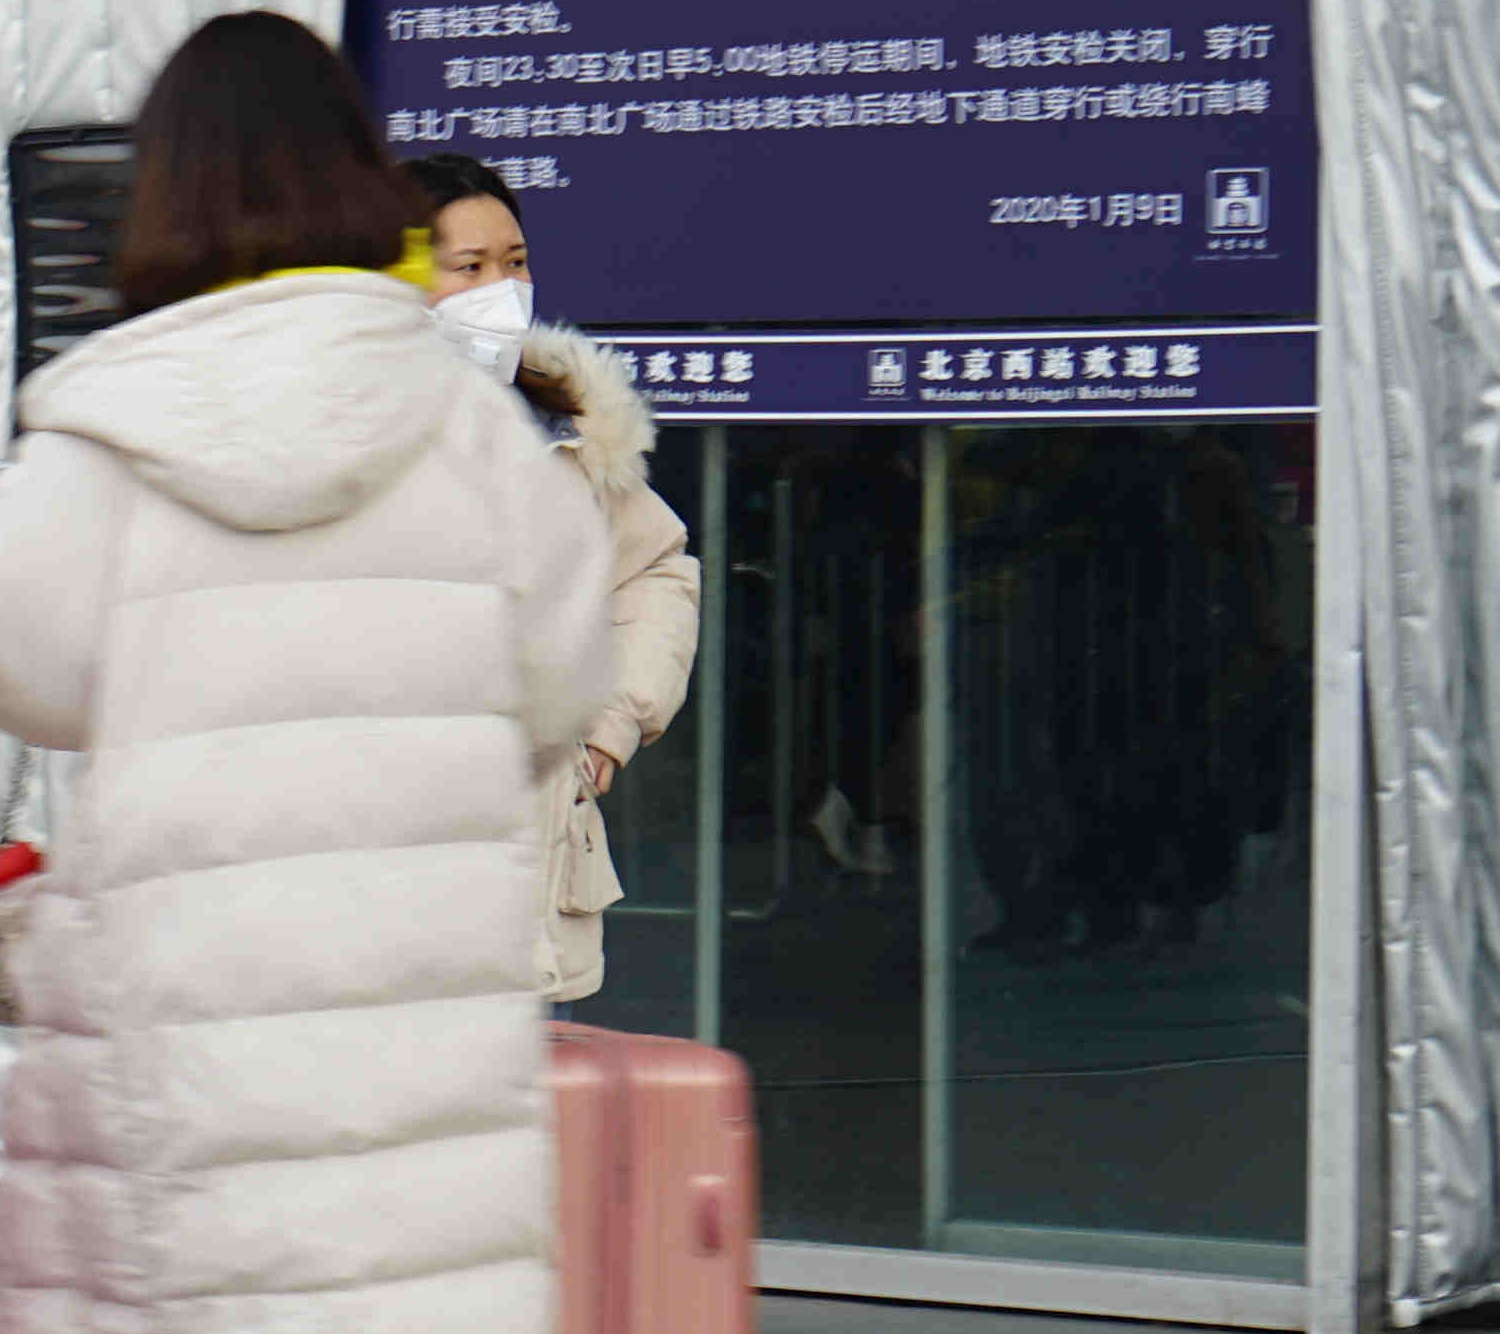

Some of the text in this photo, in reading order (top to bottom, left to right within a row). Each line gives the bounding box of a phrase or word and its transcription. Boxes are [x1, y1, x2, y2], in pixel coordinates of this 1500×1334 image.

[988, 192, 1184, 229] 2020年1月9日
[918, 343, 1201, 381] 北京西站欢迎您
